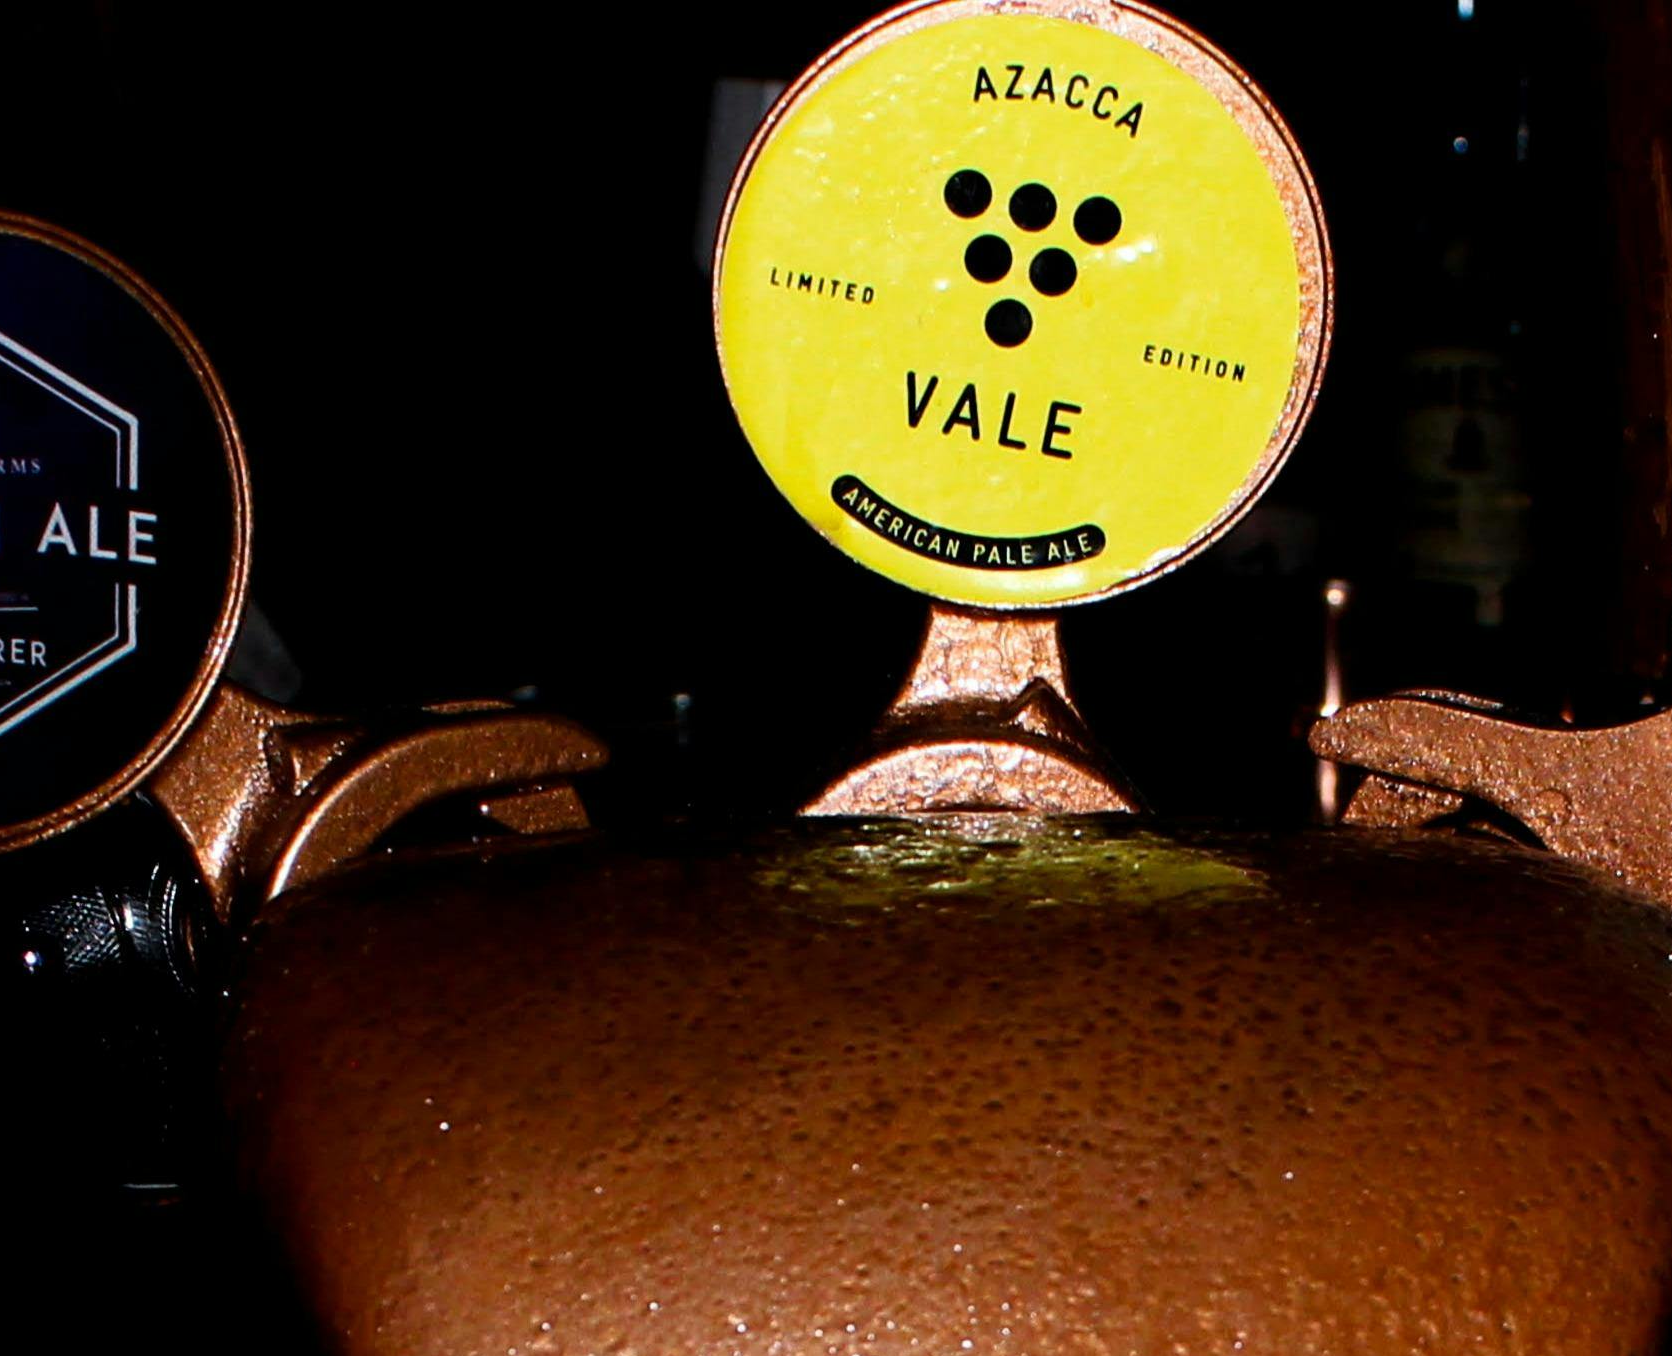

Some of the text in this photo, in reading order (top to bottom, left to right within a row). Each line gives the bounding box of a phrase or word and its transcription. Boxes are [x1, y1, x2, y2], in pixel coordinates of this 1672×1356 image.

[973, 65, 1144, 137] AZACCA
[770, 267, 875, 305] LIMITED
[1143, 345, 1247, 383] EDITION
[906, 371, 1083, 460] VALE
[36, 502, 158, 566] ALE
[841, 486, 1094, 566] AMERICAN PALE ALE
